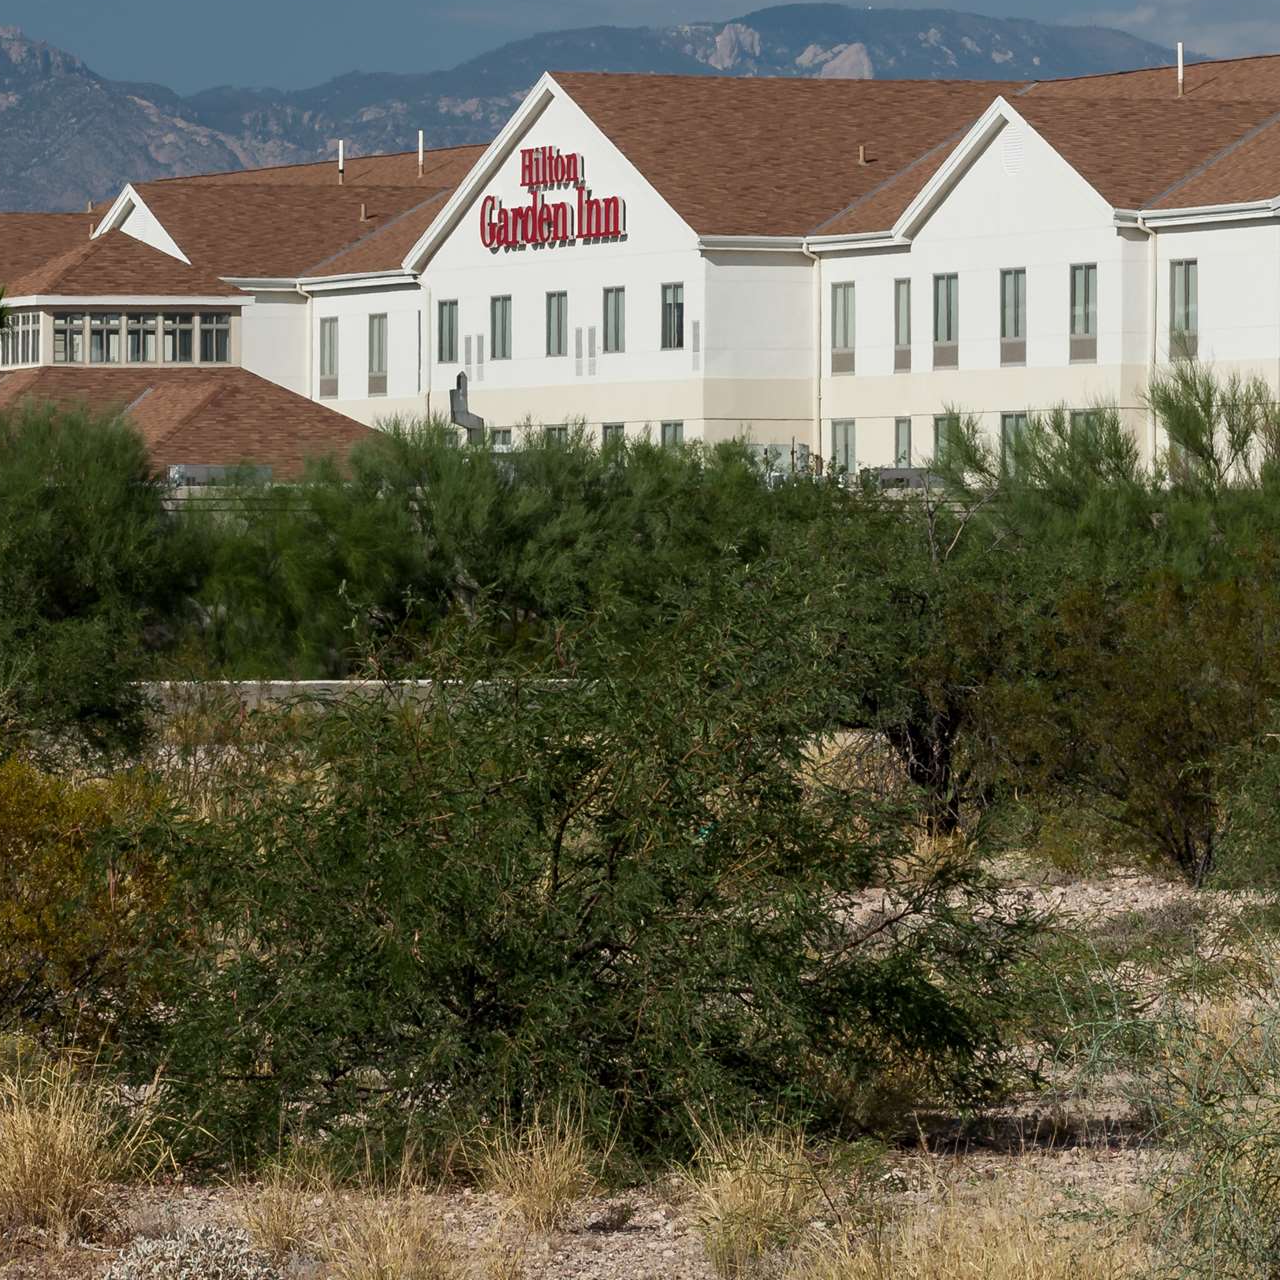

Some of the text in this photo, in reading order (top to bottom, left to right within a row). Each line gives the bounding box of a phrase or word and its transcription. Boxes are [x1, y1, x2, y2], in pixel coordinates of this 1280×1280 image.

[520, 145, 580, 187] Hilton
[480, 185, 621, 248] Garden Inn
